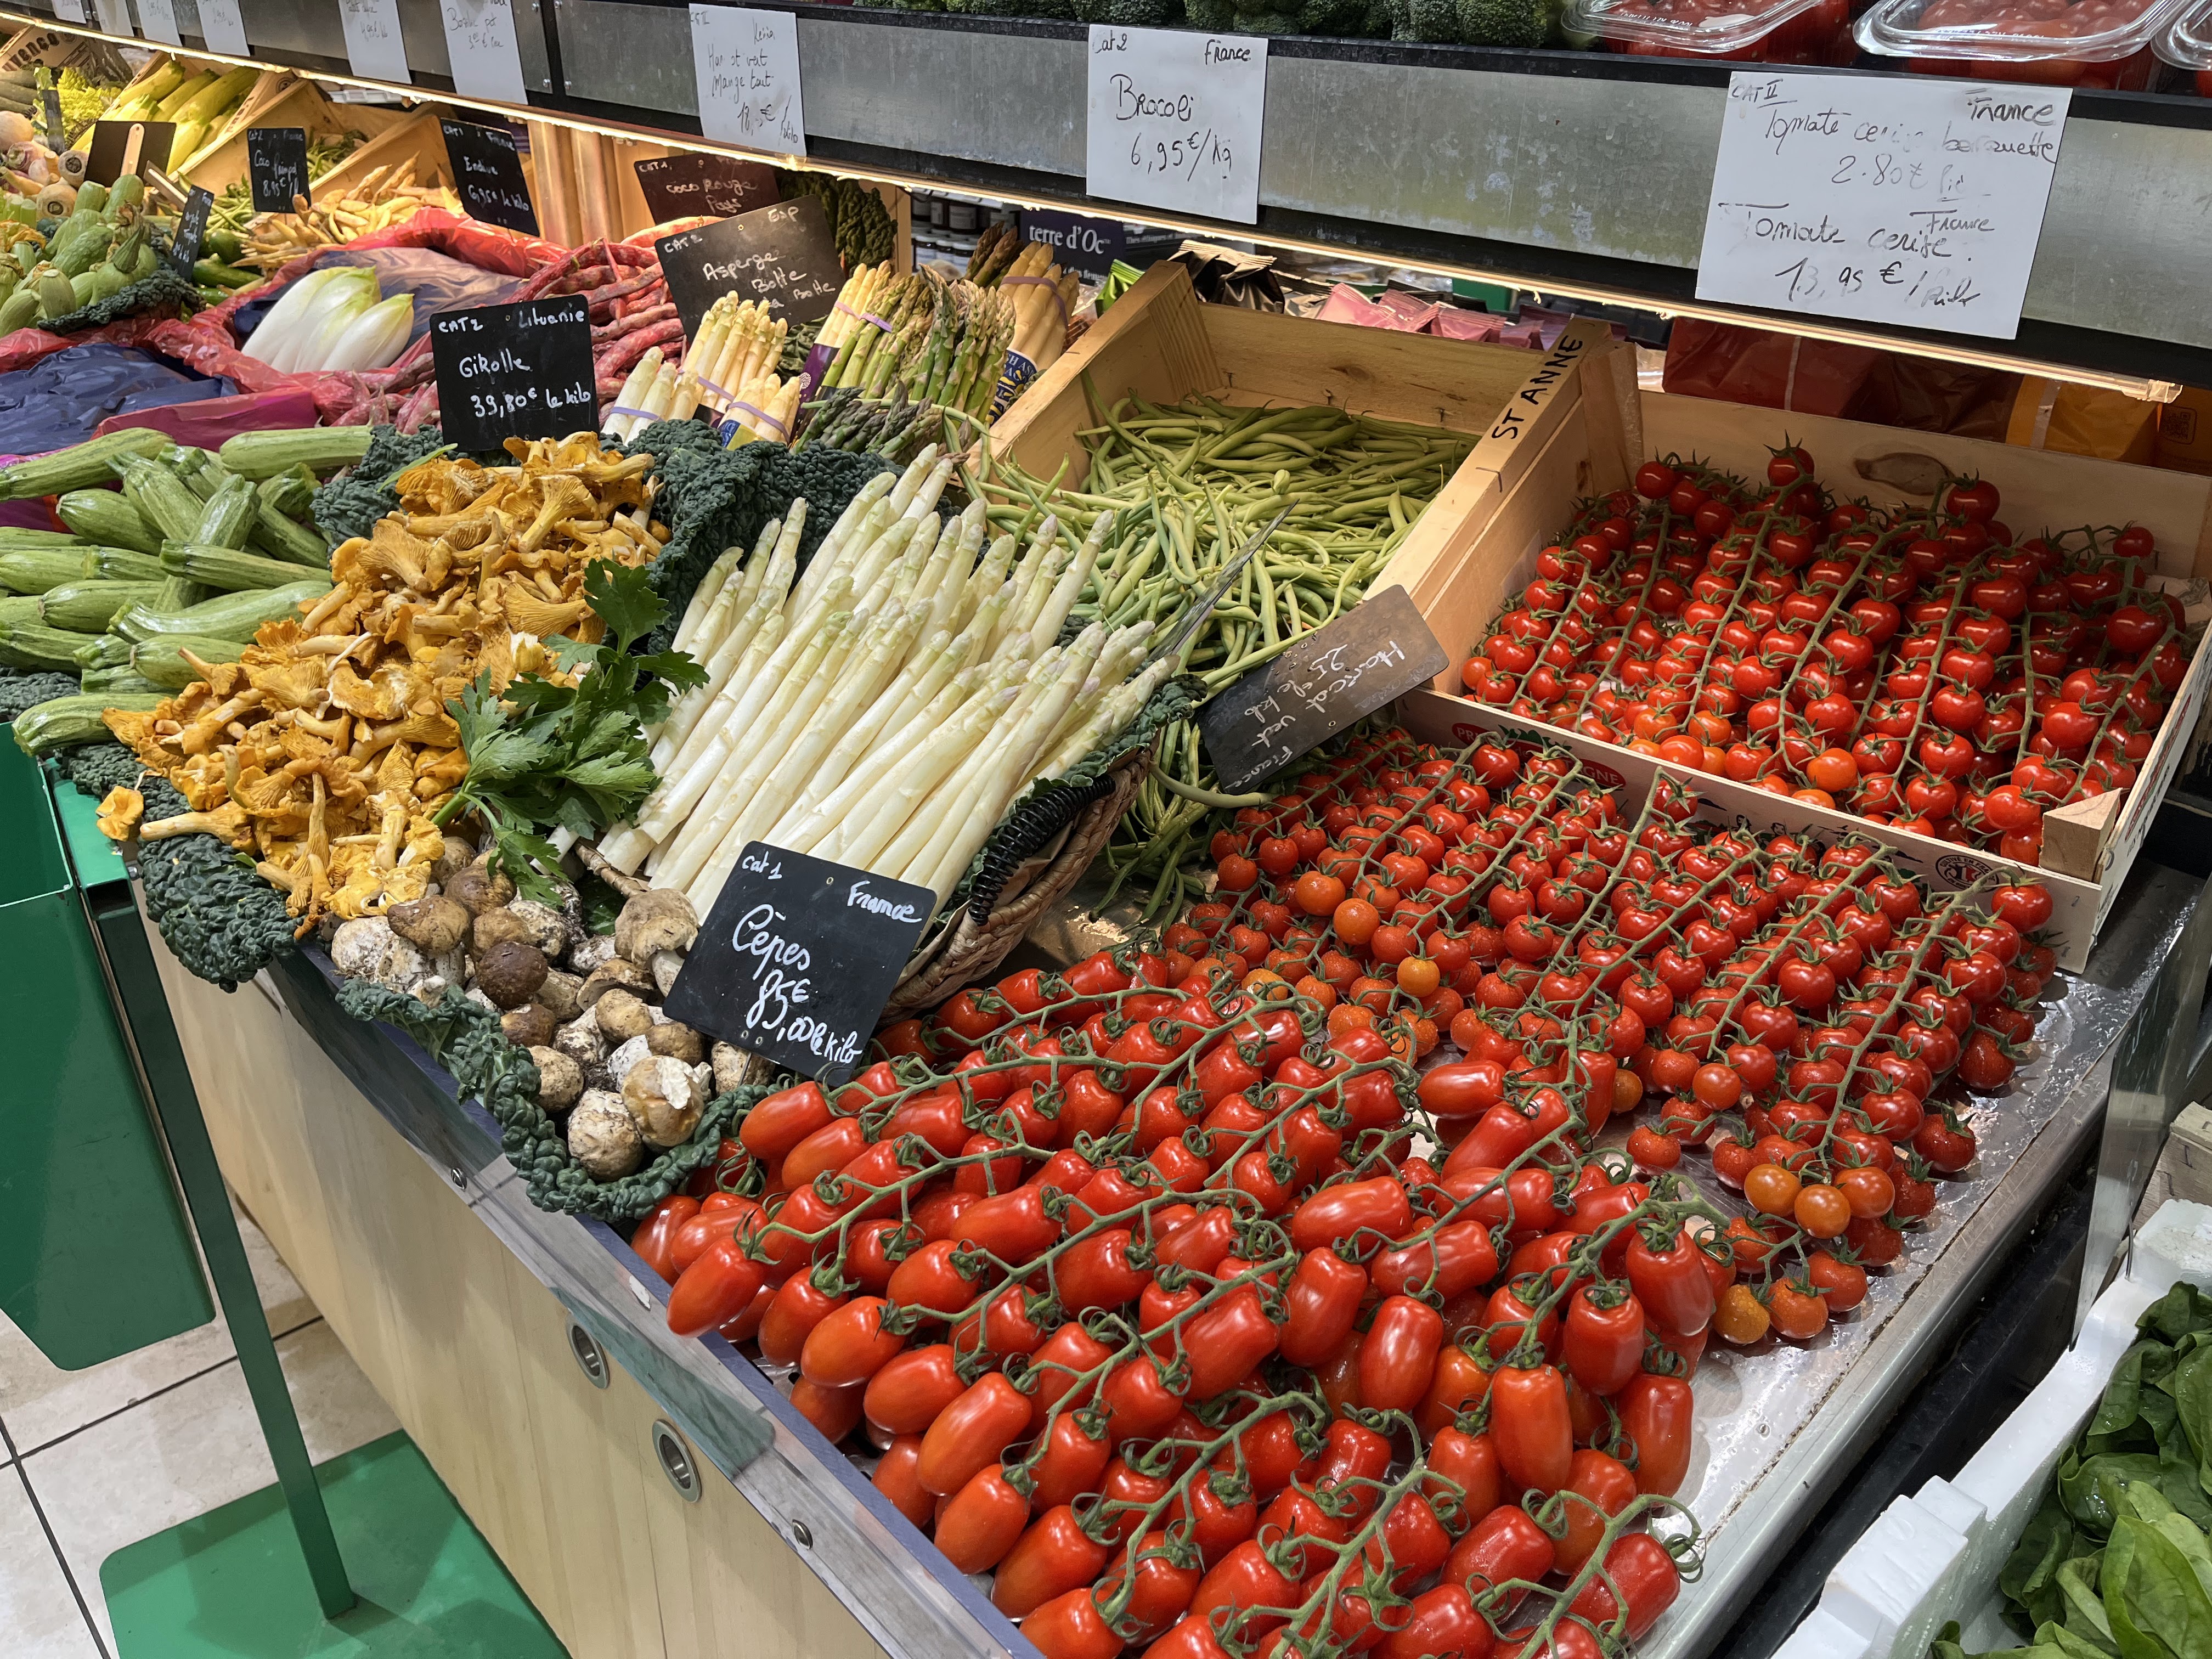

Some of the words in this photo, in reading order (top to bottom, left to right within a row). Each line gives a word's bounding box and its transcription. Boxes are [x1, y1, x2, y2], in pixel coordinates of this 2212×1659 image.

[1029, 224, 1063, 246] terre
[518, 307, 585, 328] Lituanie
[545, 388, 563, 408] le
[1491, 408, 1525, 439] ST
[1520, 335, 1583, 405] ANNE
[847, 880, 922, 923] France
